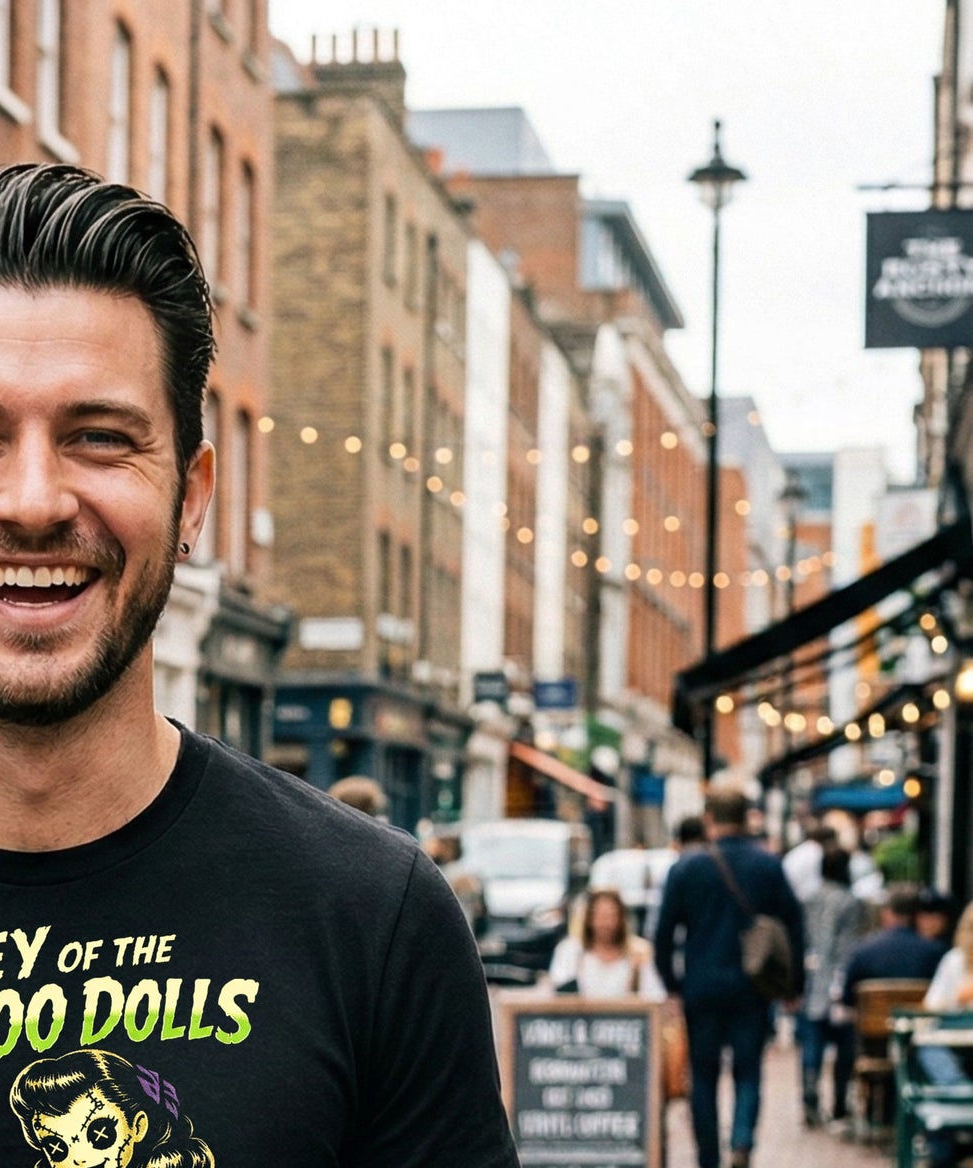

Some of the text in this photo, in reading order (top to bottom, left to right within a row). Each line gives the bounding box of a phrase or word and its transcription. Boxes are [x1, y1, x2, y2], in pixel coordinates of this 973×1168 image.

[58, 940, 103, 973] OF
[113, 934, 176, 967] THE
[80, 976, 259, 1046] DOLLS
